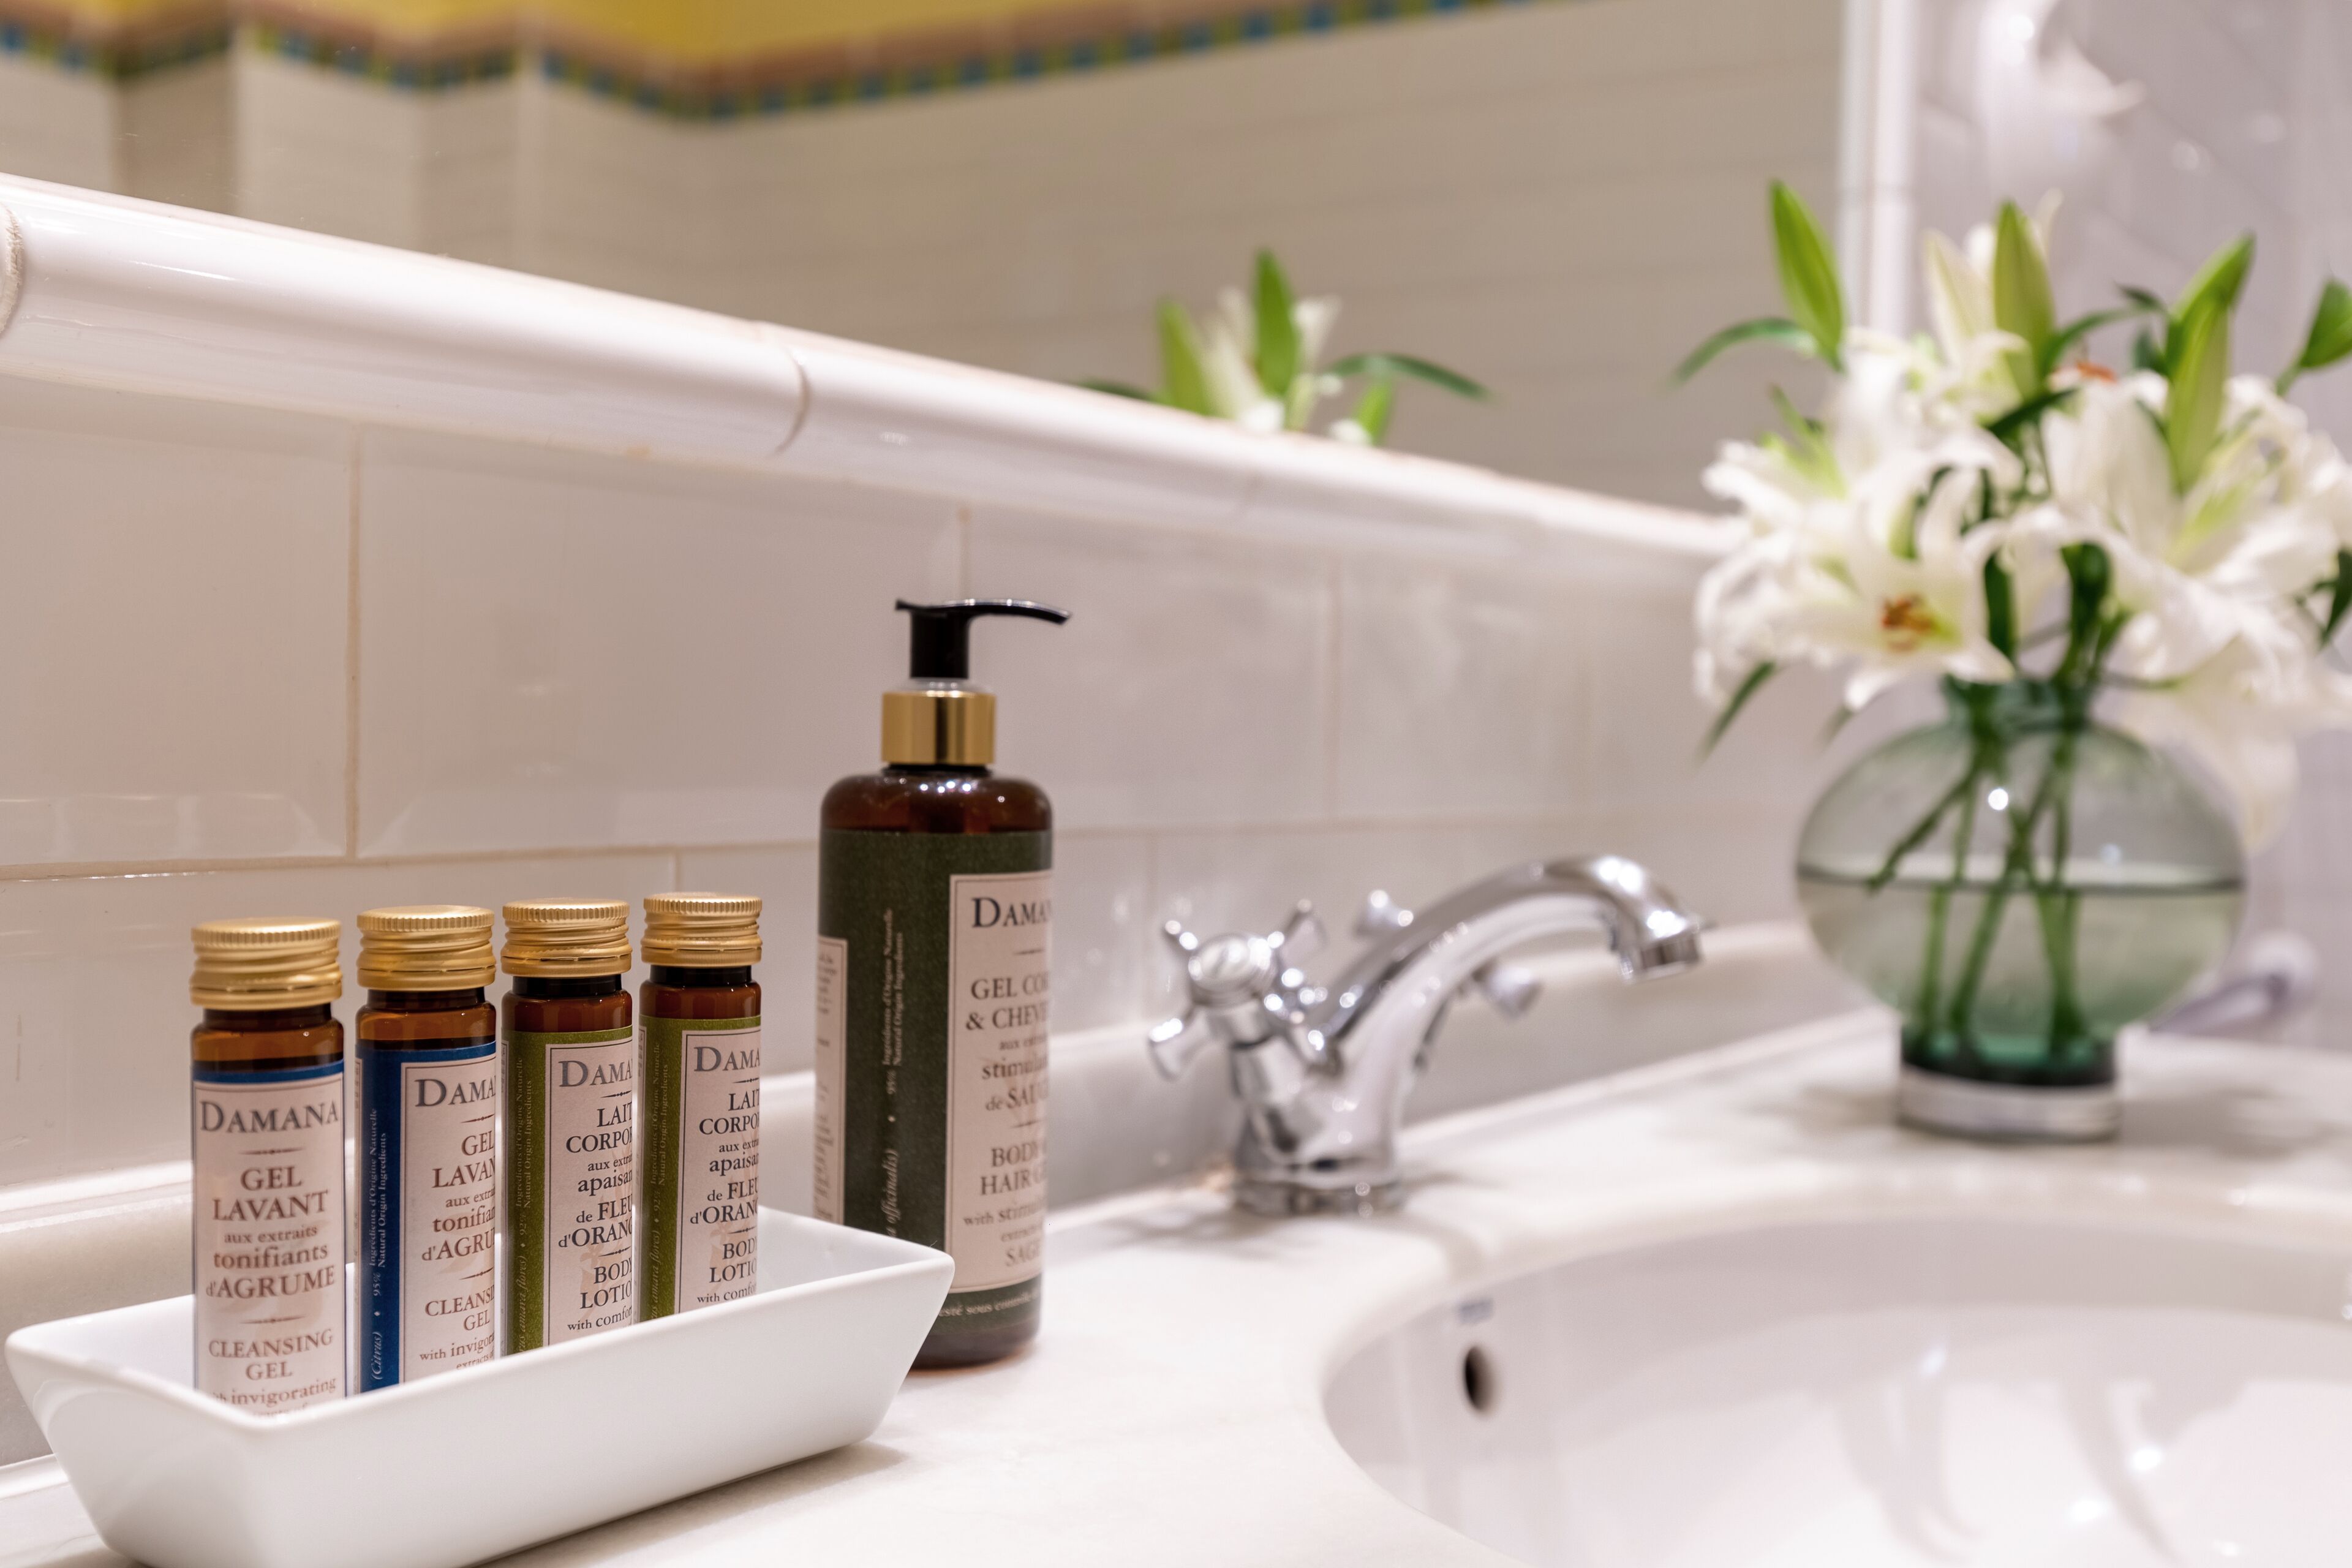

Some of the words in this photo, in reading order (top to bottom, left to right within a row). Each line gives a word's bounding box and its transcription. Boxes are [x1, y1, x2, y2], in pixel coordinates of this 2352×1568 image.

[971, 977, 1017, 1000] GEL
[966, 1012, 984, 1030] &
[558, 1058, 632, 1087] DAMA
[414, 1076, 496, 1107] DAMA
[200, 1100, 339, 1133] DAMANA
[699, 1112, 760, 1135] CORPO
[461, 1131, 494, 1156] GEL
[719, 1144, 739, 1152] aux
[378, 1133, 387, 1190] Ingredients
[587, 1161, 611, 1171] aux
[240, 1166, 303, 1191] GEL
[212, 1189, 328, 1221] LAVANT
[445, 1196, 470, 1208] aux
[707, 1189, 722, 1201] de
[378, 1193, 387, 1226] Origin
[576, 1210, 592, 1223] de
[224, 1233, 252, 1243] aux
[257, 1223, 318, 1243] extraits
[421, 1227, 495, 1261] d'AGRU
[213, 1245, 328, 1270] tonifiants
[722, 1236, 757, 1259] BOD
[205, 1265, 335, 1299] d'AGRUME
[697, 1293, 720, 1303] with
[463, 1310, 490, 1331] GEL
[567, 1319, 592, 1330] with
[208, 1329, 333, 1359] CLEANSING
[420, 1349, 446, 1360] with
[371, 1332, 383, 1380] (Citrus)
[246, 1361, 293, 1381] GEL
[232, 1378, 336, 1408] invigorating
